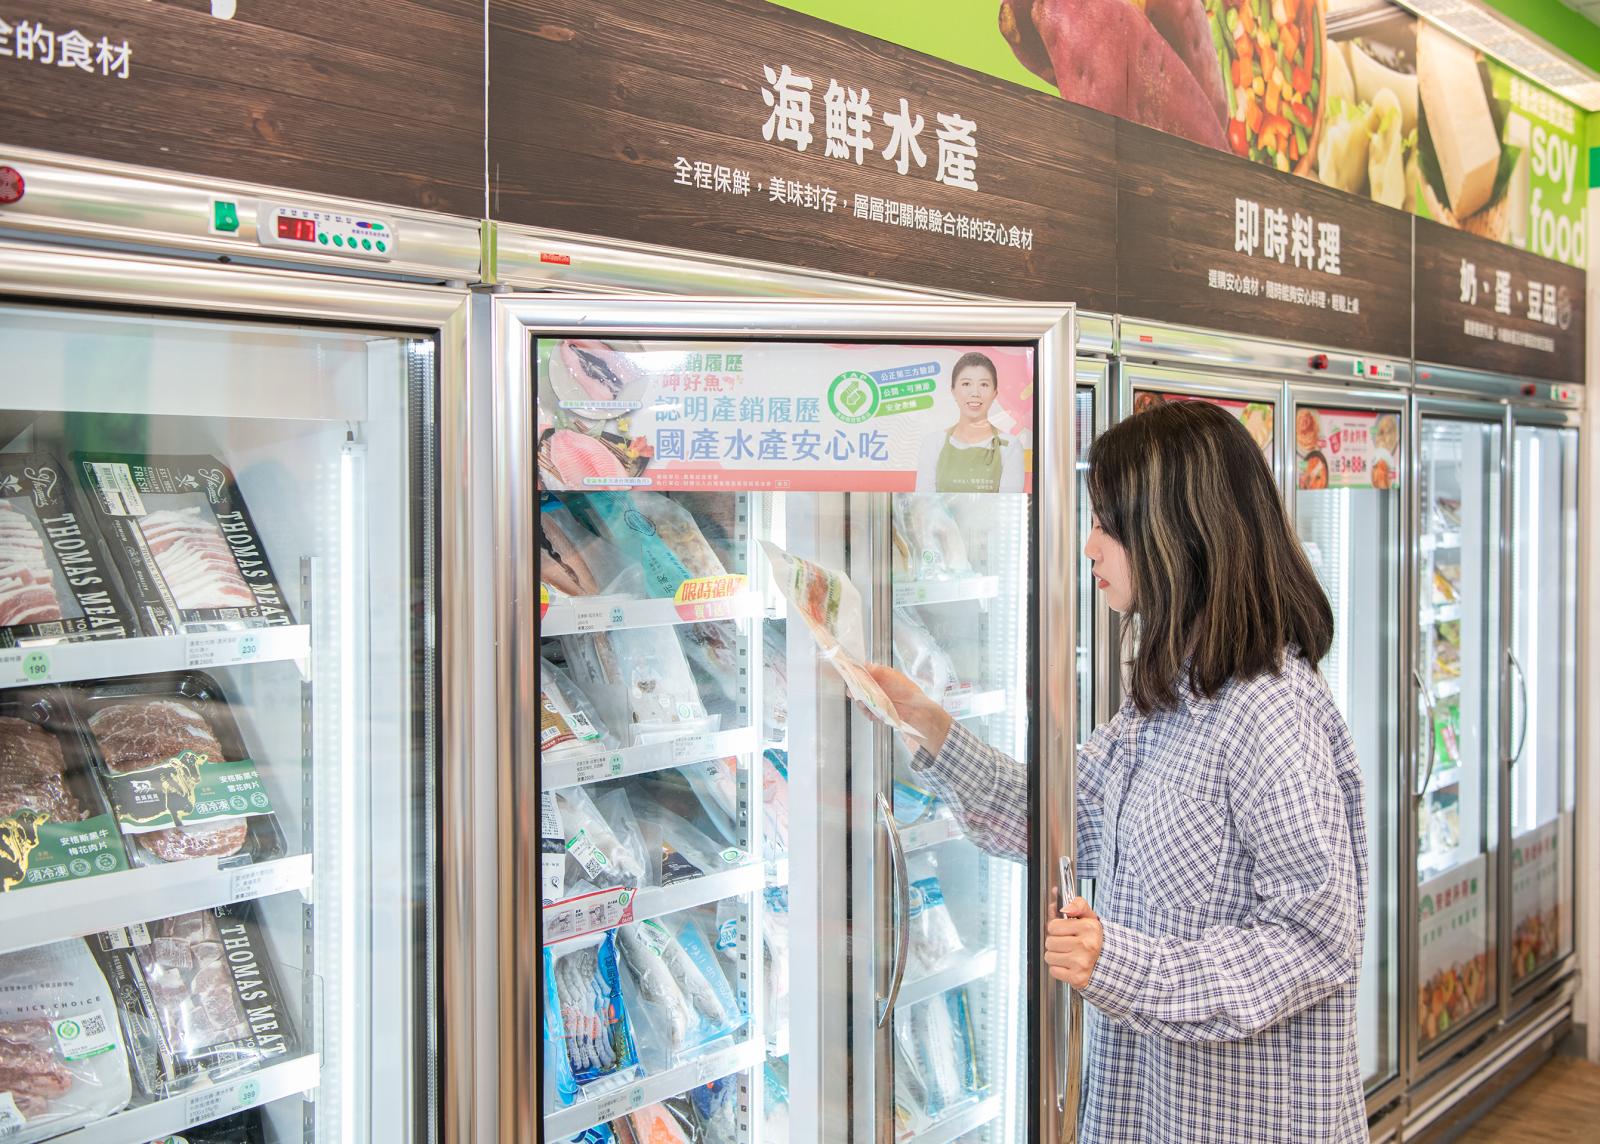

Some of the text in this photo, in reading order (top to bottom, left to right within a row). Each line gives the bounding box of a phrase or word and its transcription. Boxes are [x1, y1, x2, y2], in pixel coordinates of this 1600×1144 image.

[761, 64, 978, 191] 海鮮水產
[1531, 126, 1578, 205] soy
[1234, 197, 1342, 276] 即時料理
[1530, 187, 1587, 268] food
[674, 353, 743, 373] 銷履歷
[655, 394, 820, 424] 認明產銷履歷
[655, 427, 889, 462] 國產水產安心吃
[133, 466, 151, 493] FRESH
[42, 512, 127, 638] THOMAS MEAT
[216, 511, 291, 626] THOMAS MEAT
[30, 664, 46, 674] 190
[54, 996, 100, 1009] CHOICE
[221, 924, 268, 1001] THOMAS
[247, 1004, 287, 1055] MEAT
